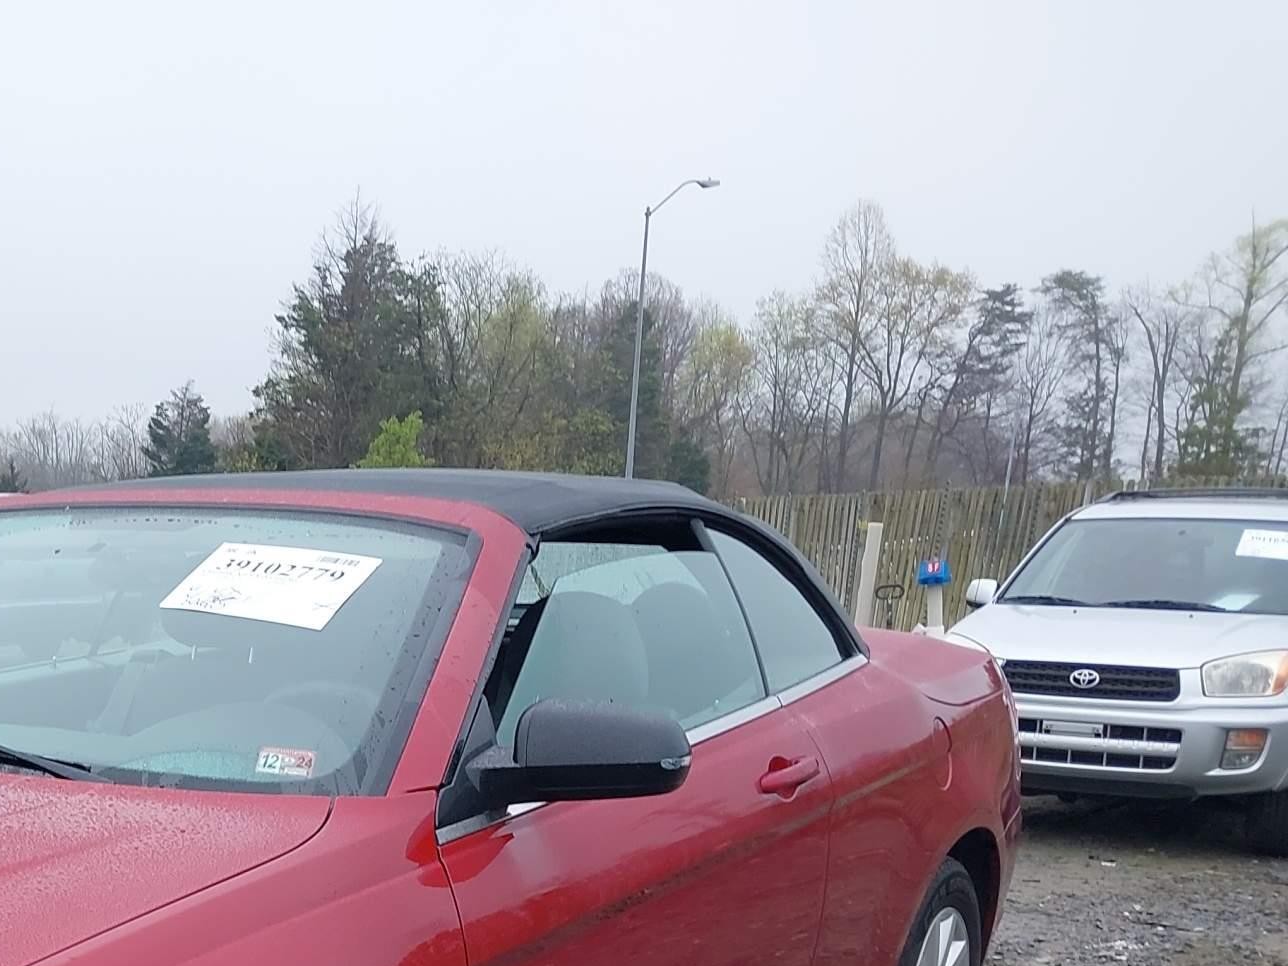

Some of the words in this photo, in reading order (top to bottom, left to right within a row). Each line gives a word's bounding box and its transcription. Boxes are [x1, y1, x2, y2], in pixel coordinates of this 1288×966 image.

[214, 558, 346, 581] 39102779
[262, 753, 280, 769] 12
[295, 755, 313, 769] 24
